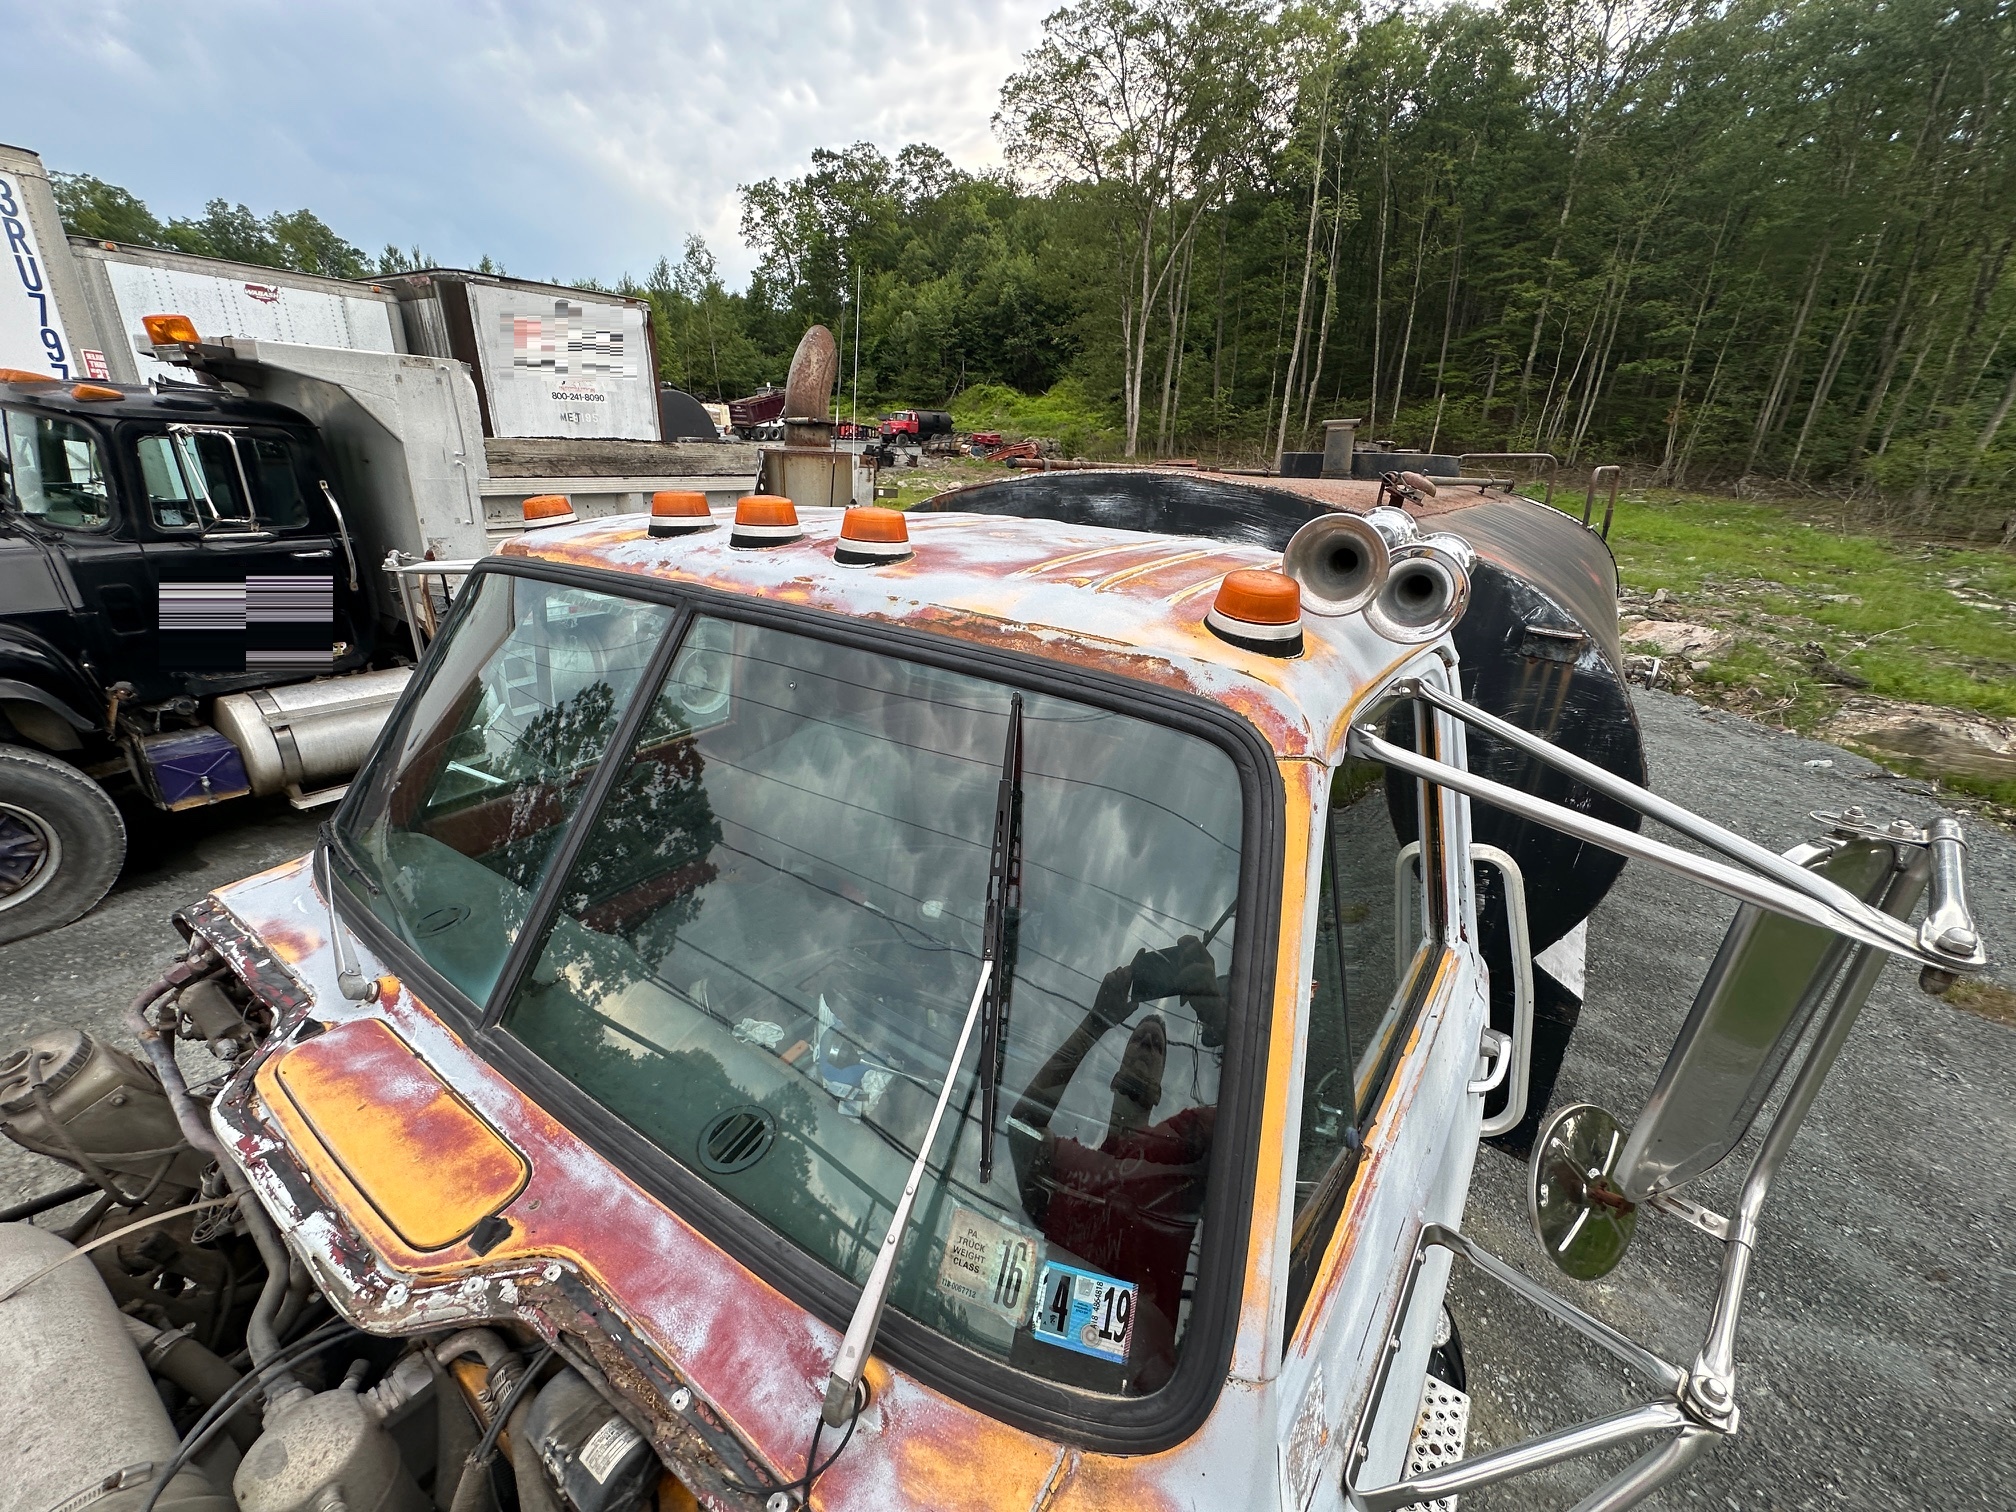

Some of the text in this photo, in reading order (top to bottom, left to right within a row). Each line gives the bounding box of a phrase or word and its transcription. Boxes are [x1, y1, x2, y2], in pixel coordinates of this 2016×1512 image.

[244, 289, 280, 300] WABASH
[551, 391, 605, 402] 800-241-8090
[958, 1236, 986, 1253] TRUCK
[953, 1245, 986, 1264] WEIGHT
[953, 1257, 980, 1274] CLASS
[993, 1238, 1028, 1310] 16
[1049, 1275, 1071, 1333] 4
[1098, 1286, 1131, 1343] 19
